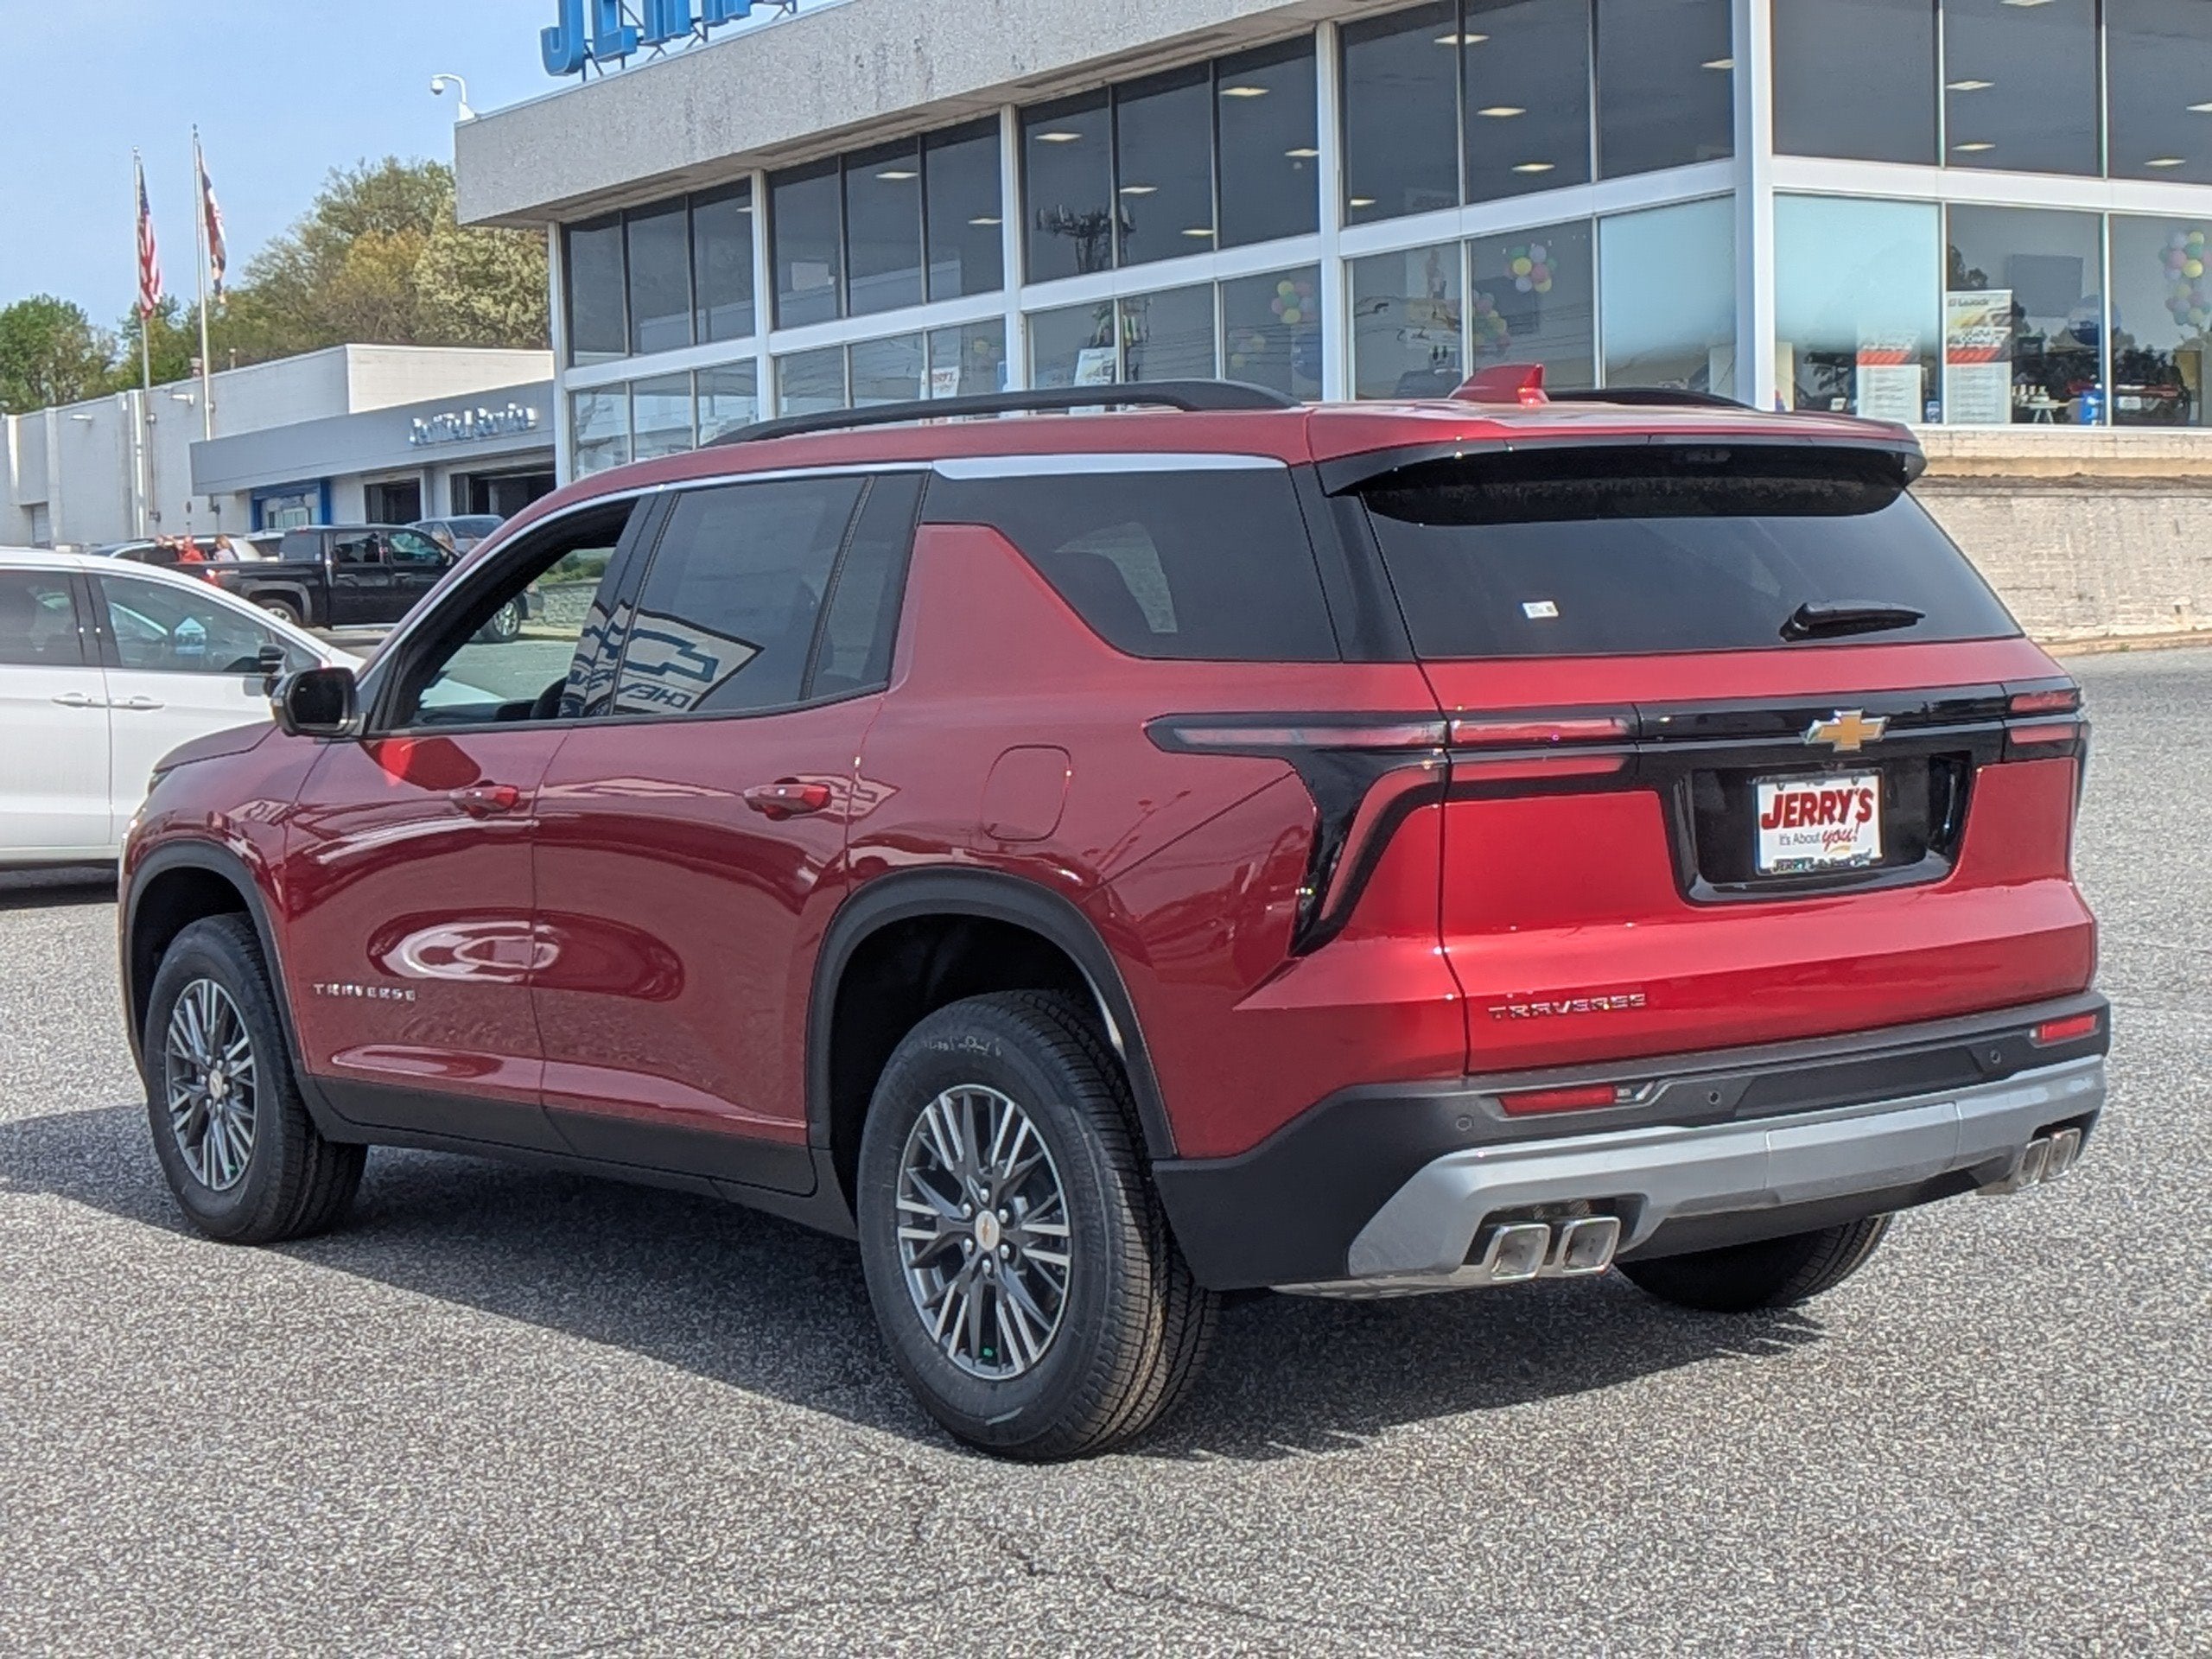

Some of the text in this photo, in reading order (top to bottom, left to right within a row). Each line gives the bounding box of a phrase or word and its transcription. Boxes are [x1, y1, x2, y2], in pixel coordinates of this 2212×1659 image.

[1761, 787, 1874, 830] JERRY'S
[1779, 822, 1859, 853] It's About you!
[313, 983, 415, 1001] TRAVERSE
[1488, 994, 1647, 1020] TRAVERSE
